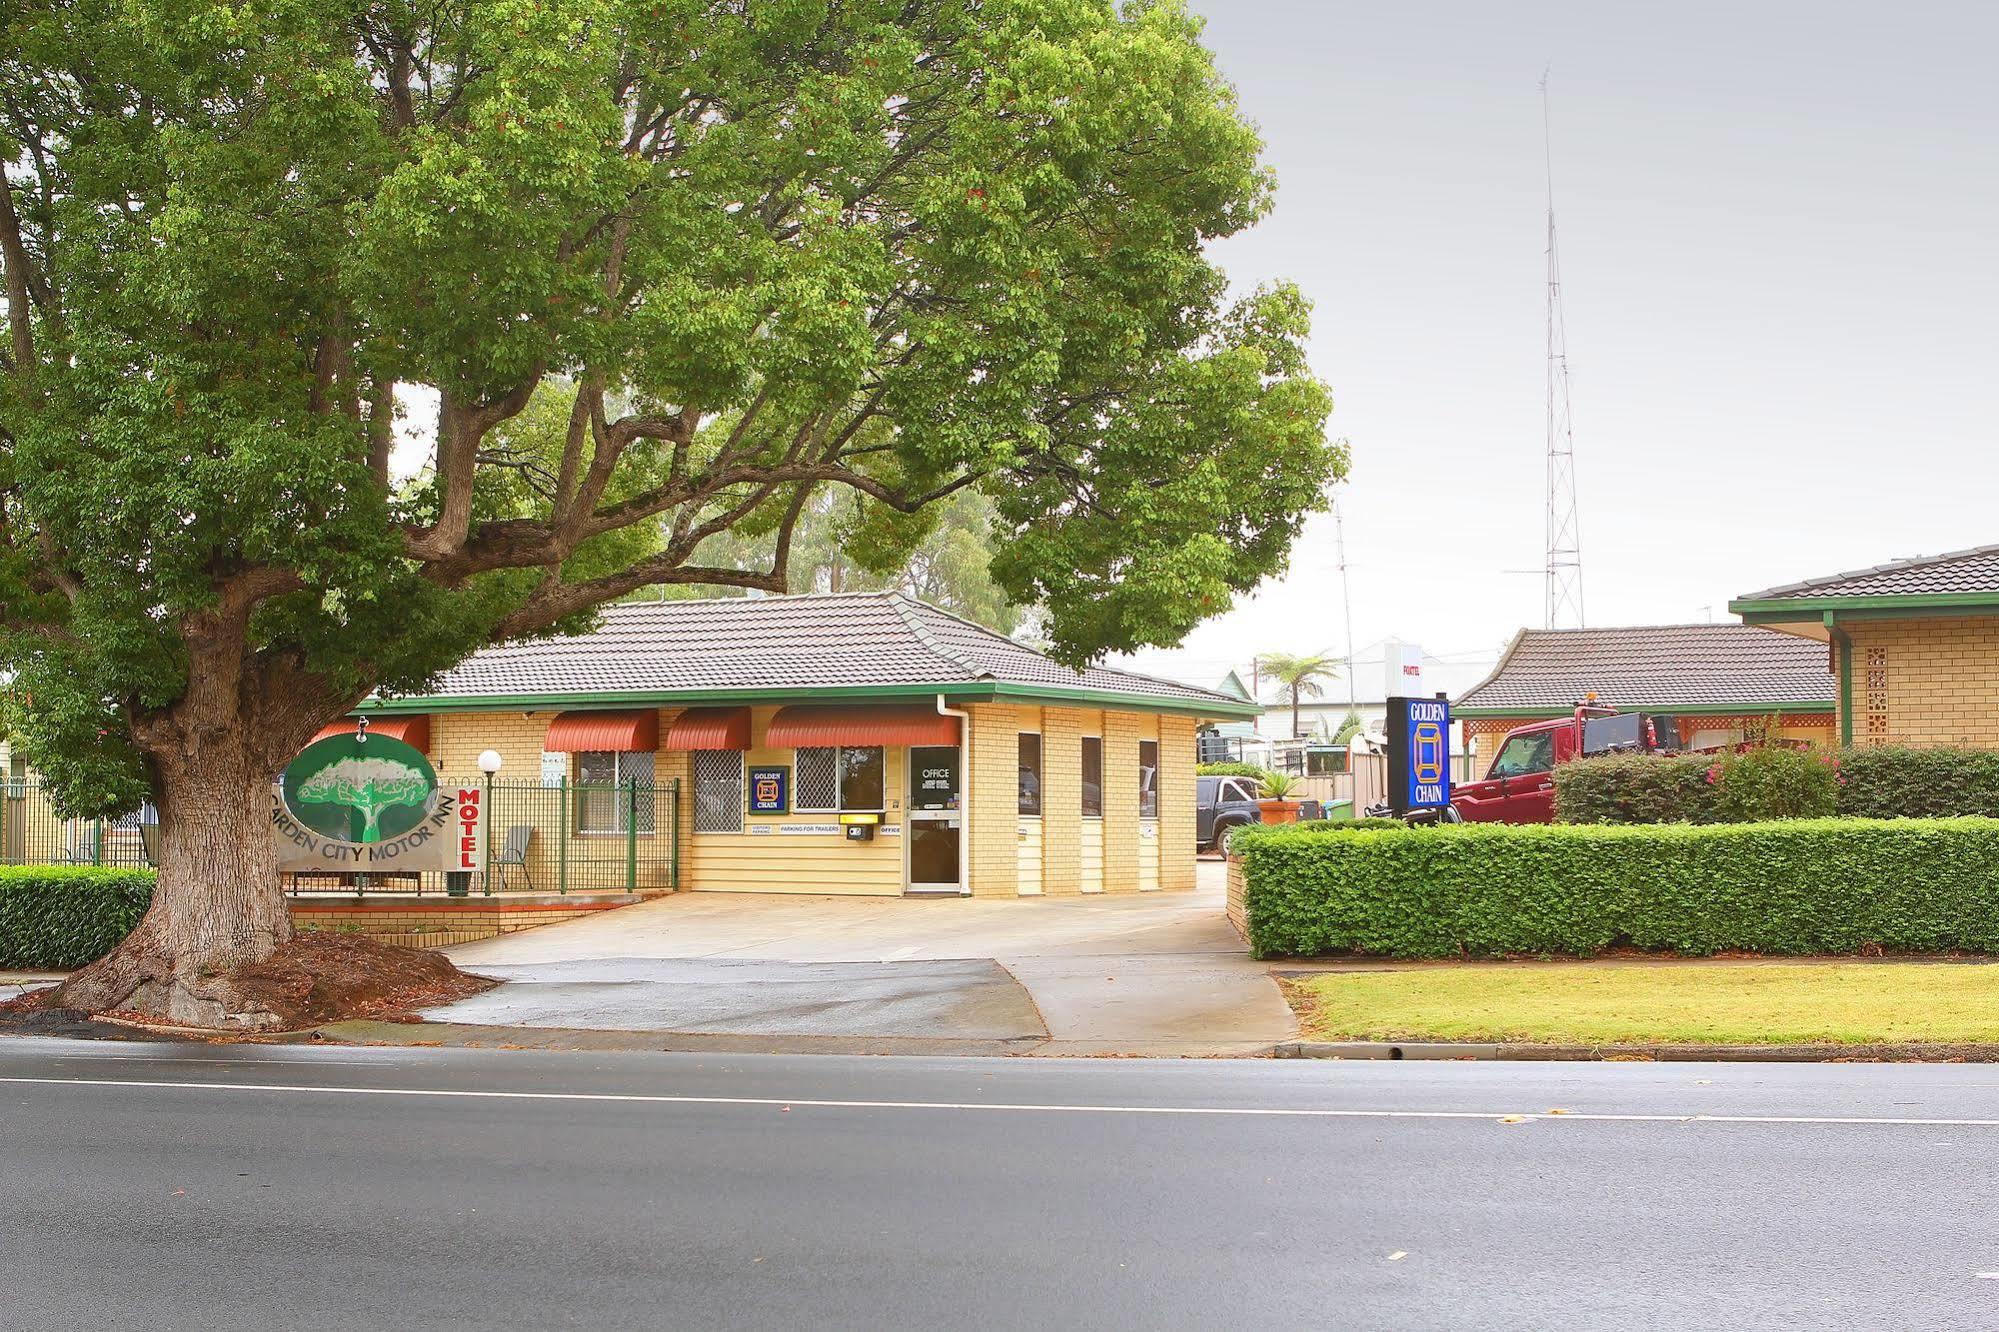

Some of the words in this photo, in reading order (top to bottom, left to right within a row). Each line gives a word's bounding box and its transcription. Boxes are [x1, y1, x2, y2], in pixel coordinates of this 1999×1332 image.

[1410, 703, 1445, 722] GOLDEN
[922, 768, 949, 778] OFFICE
[1415, 784, 1442, 803] CHAIN
[757, 801, 778, 809] CHAIN
[322, 842, 363, 861] CITY
[369, 825, 434, 861] MOTOR
[430, 795, 456, 828] INN
[458, 789, 480, 868] MOTEL
